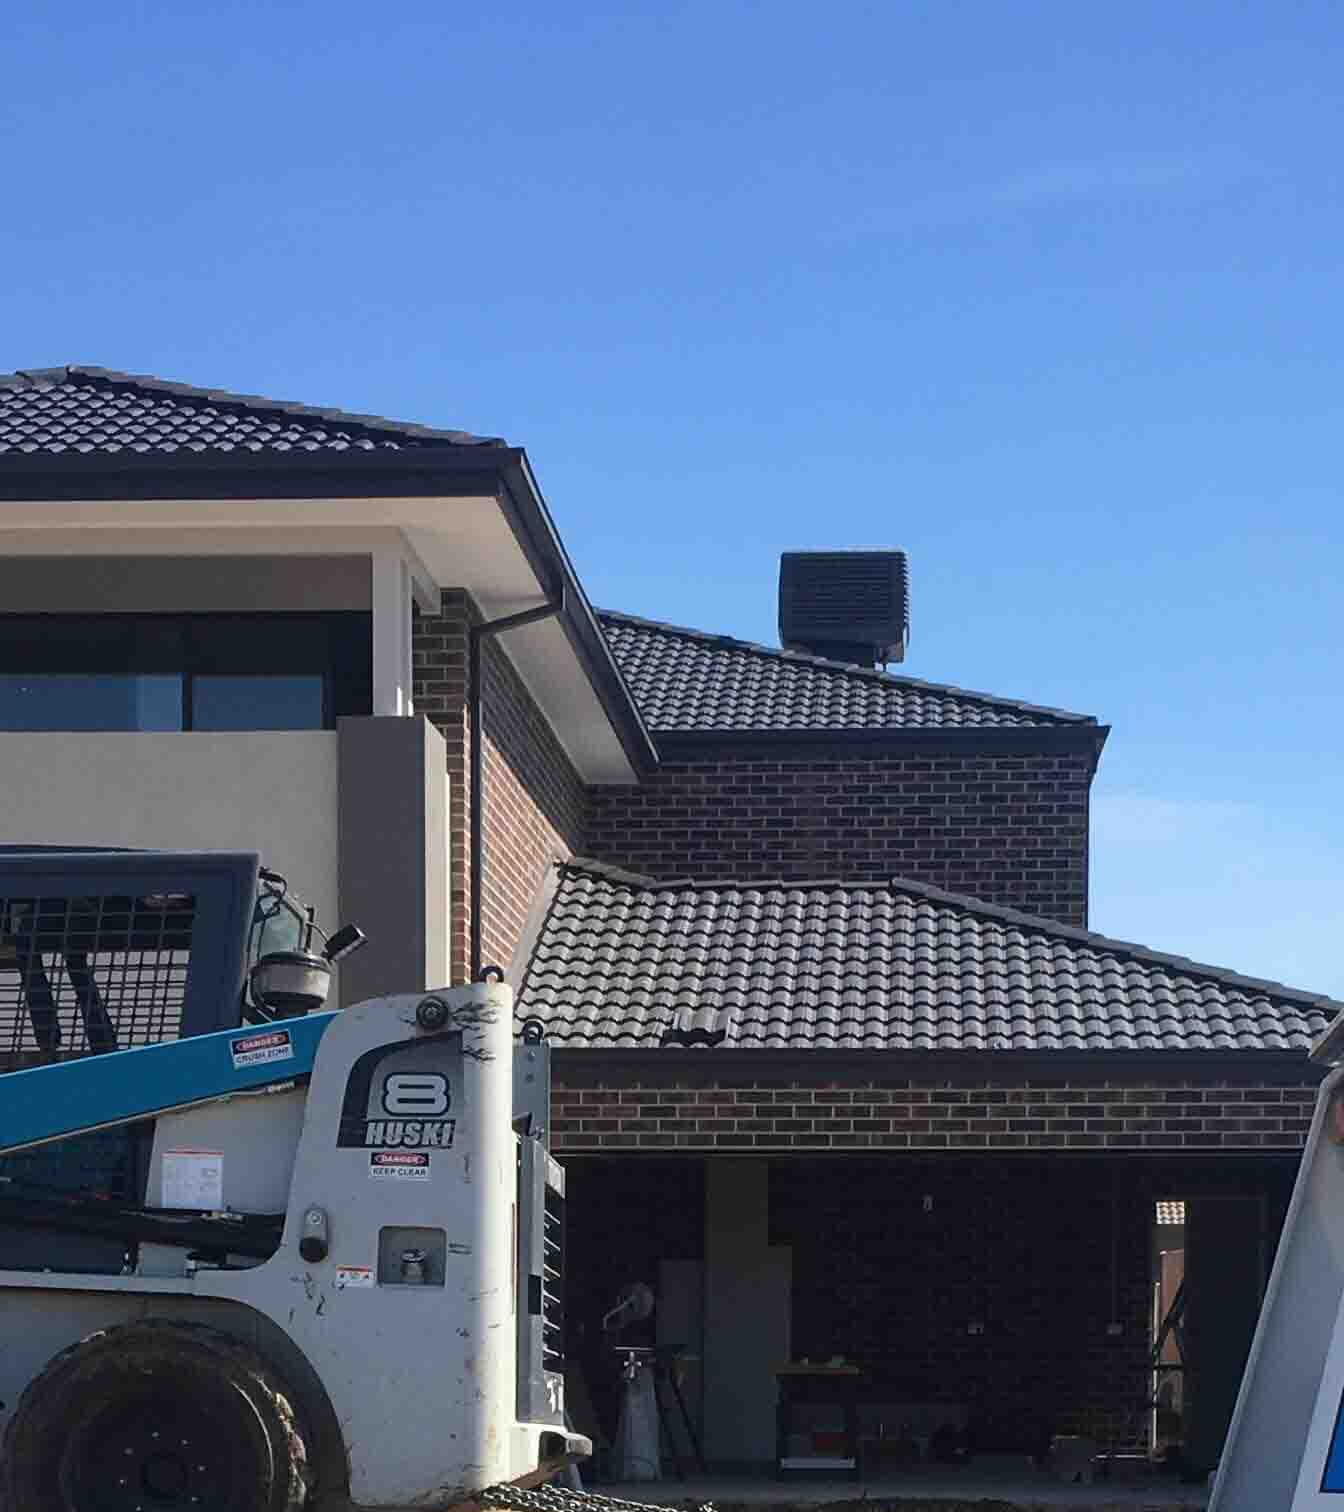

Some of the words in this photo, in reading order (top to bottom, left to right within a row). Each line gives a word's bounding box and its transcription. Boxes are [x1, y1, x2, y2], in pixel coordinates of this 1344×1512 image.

[382, 1072, 451, 1117] 8
[364, 1120, 455, 1148] HUSKI
[372, 1167, 396, 1176] KEEP
[397, 1167, 427, 1177] CLEAR
